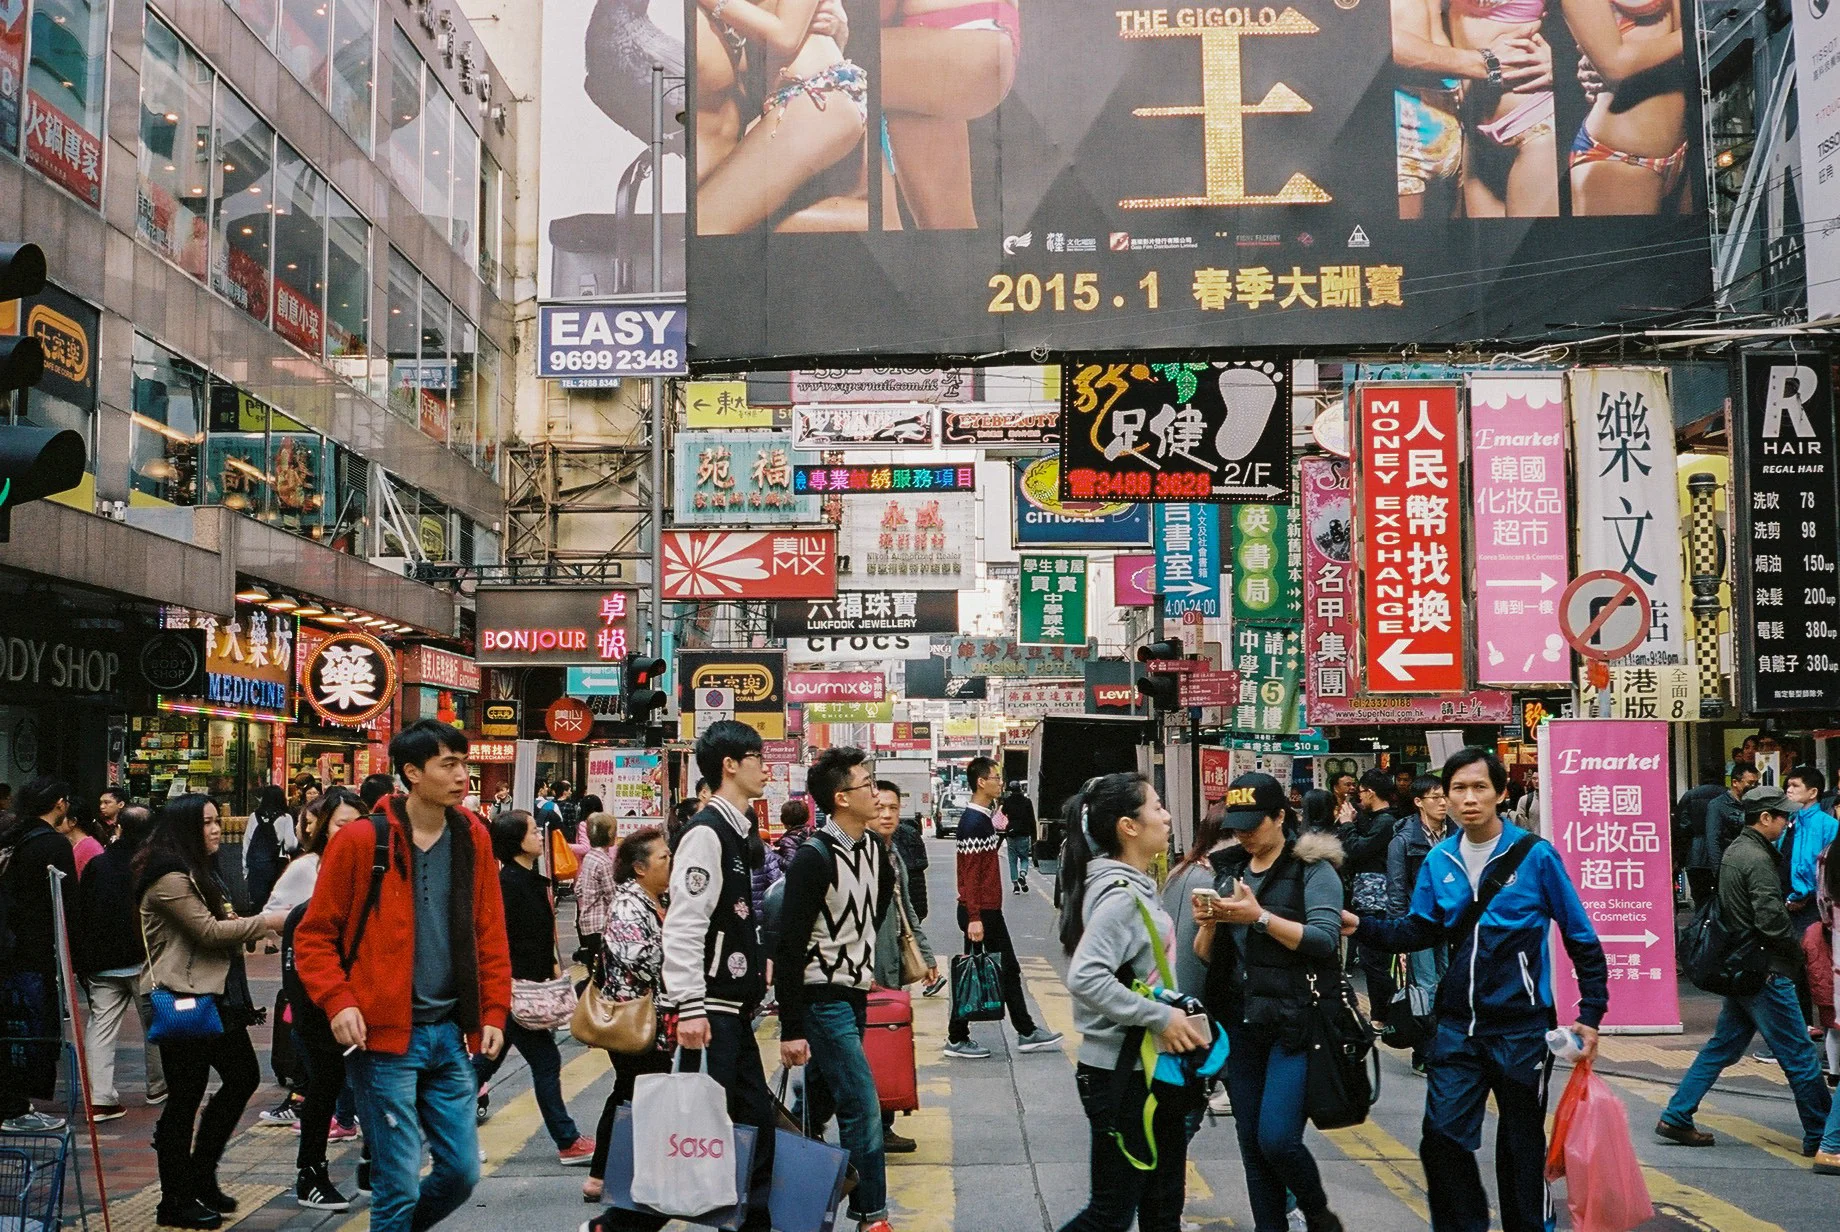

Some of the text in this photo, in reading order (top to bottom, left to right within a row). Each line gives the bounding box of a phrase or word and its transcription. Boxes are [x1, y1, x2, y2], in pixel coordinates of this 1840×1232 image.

[1116, 7, 1277, 33] THE GIGOLO
[27, 100, 99, 182] 火鍋專家
[1193, 265, 1405, 311] 春季大酬賓
[551, 311, 677, 346] EASY
[550, 349, 678, 370] 9699 2348
[562, 379, 619, 388] TEL: 2988 8348
[798, 379, 939, 394] www.supernail.com.hk
[1762, 366, 1818, 438] R
[959, 413, 1060, 429] EYEBEAUTY
[1475, 428, 1560, 450] Emarket
[1763, 441, 1822, 454] HAIR
[1224, 462, 1272, 485] 2/F
[1491, 456, 1547, 484] 韓國
[1762, 465, 1824, 474] REGAL HAIR
[1753, 492, 1815, 509] 洗吹 78
[1371, 400, 1405, 634] MONEY EXCHANGE
[1404, 399, 1452, 633] 人民幣找換
[1492, 519, 1549, 546] 超市
[1754, 521, 1816, 539] 洗剪 98
[773, 537, 826, 555] 美心
[773, 556, 826, 575] MX
[891, 552, 933, 560] Authorized
[1755, 554, 1782, 572] 焗油
[1023, 559, 1085, 574] 學生書屋
[807, 592, 918, 620] 六福珠寶
[1756, 588, 1783, 606] 染髮
[807, 618, 918, 630] LUKFOOK JEWELLERY
[1041, 593, 1065, 638] 中學課本
[1315, 562, 1348, 697] 名甲集團
[1757, 621, 1784, 639] 電髮
[484, 630, 588, 652] BONJOUR
[807, 636, 910, 652] crocs
[51, 643, 119, 692] SHOP
[151, 658, 189, 669] BODY
[1758, 654, 1799, 673] 負離子
[153, 669, 185, 680] SHOP
[318, 644, 379, 710] 藥
[1237, 630, 1260, 730] 中學舊書
[208, 671, 286, 709] MEDICINE
[1391, 698, 1412, 707] 0188
[554, 720, 582, 732] MX
[1294, 743, 1311, 751] $10
[1557, 748, 1661, 774] Emarket
[1579, 785, 1642, 816] 韓國
[1580, 858, 1645, 890] 超市
[1583, 899, 1652, 909] orea Skincare
[1592, 911, 1647, 922] Cosmetics
